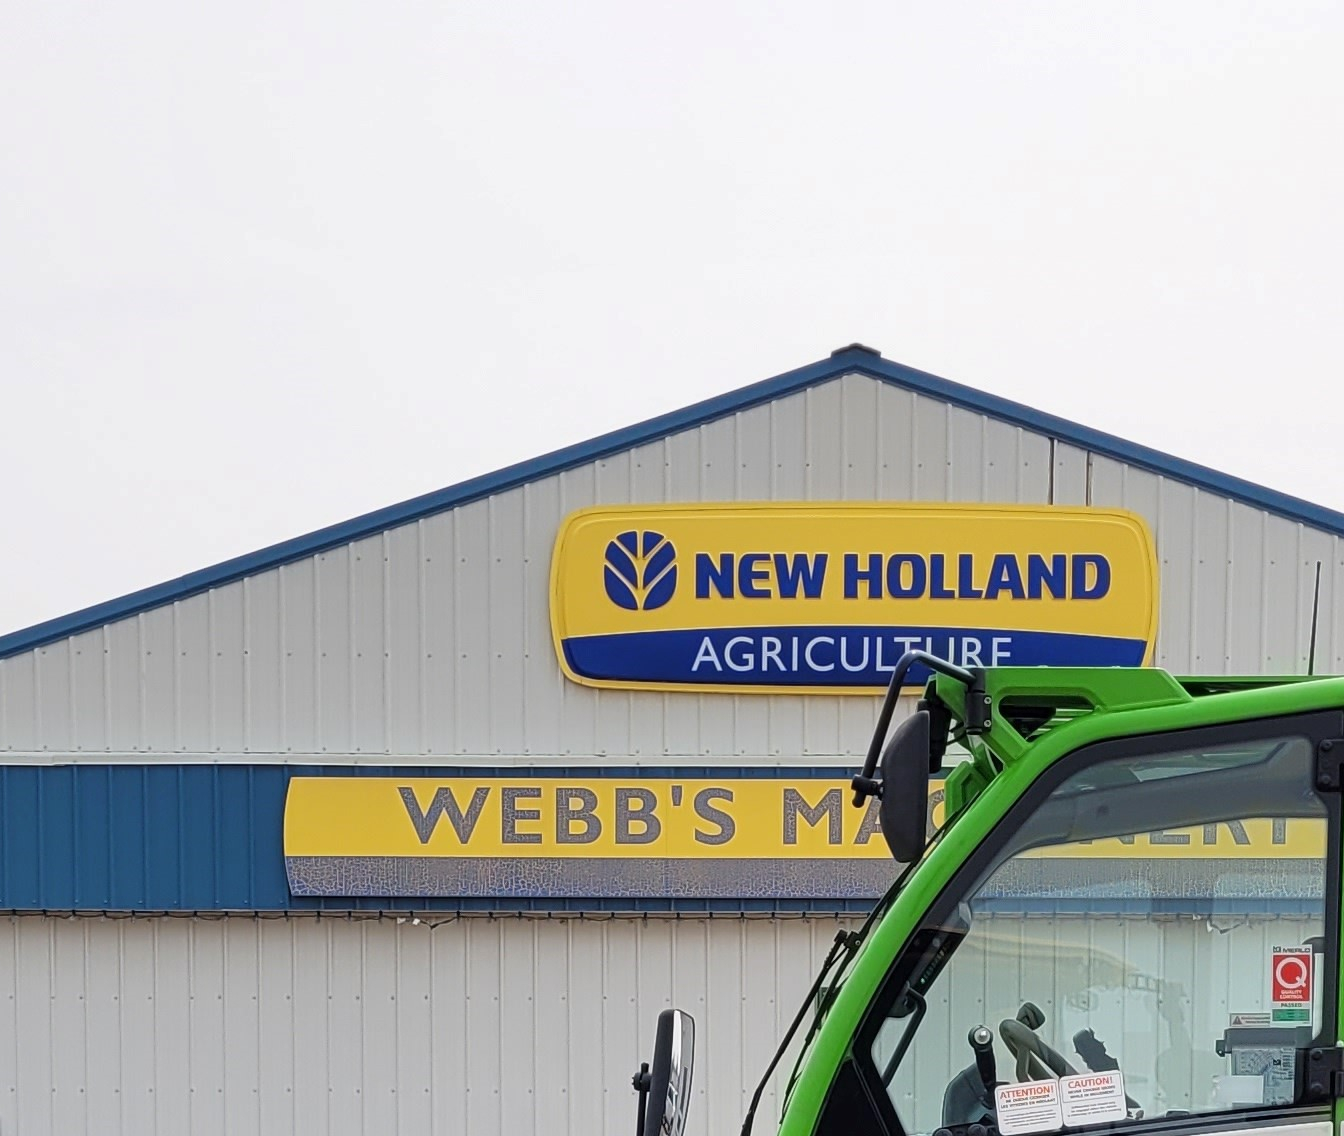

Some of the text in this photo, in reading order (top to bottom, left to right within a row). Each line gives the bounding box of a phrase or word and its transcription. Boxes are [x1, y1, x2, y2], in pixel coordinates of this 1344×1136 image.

[695, 553, 1112, 599] NEW HOLLAND
[397, 785, 737, 846] WEBB'S
[1000, 1085, 1054, 1099] ATTENTION!
[1068, 1076, 1113, 1089] CAUTION!
